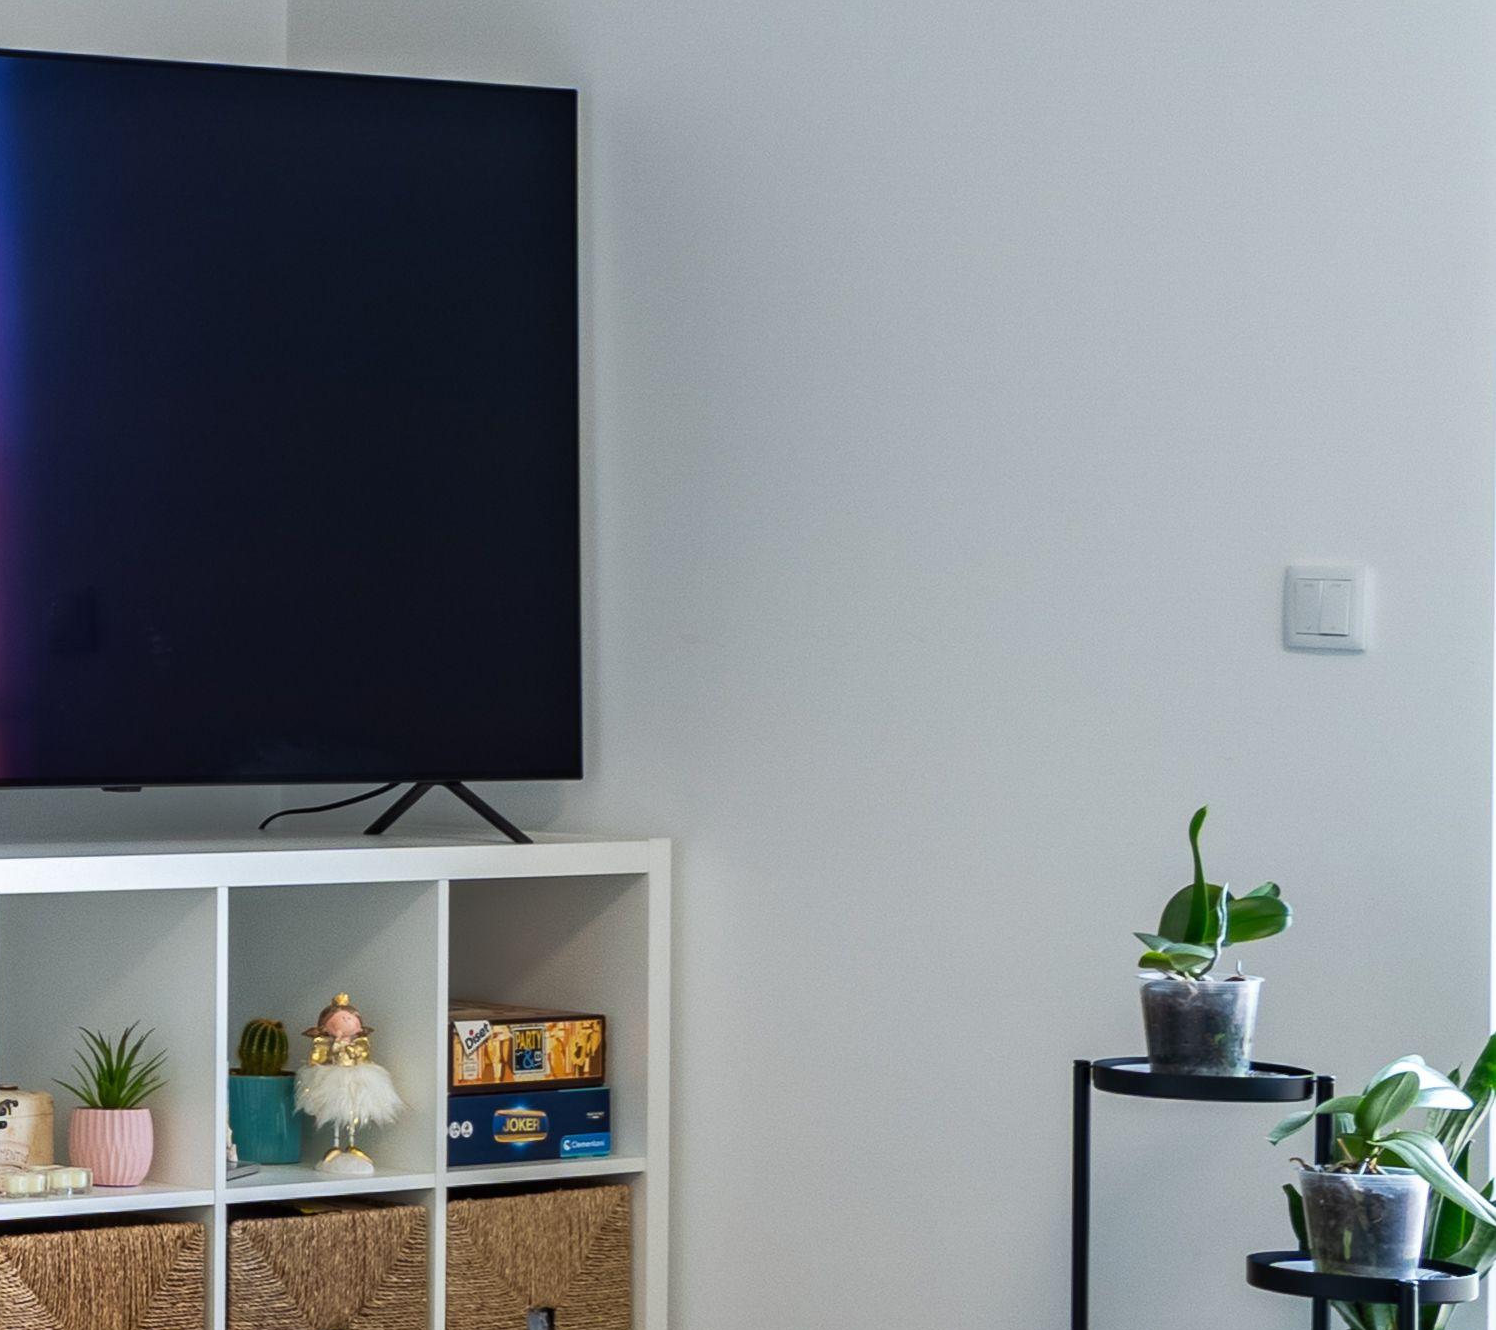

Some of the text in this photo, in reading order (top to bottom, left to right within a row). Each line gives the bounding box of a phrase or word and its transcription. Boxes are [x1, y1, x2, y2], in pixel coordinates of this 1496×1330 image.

[465, 1022, 490, 1050] Diset
[515, 1031, 543, 1050] PARTY
[522, 1050, 536, 1068] &
[503, 1118, 541, 1132] JOKER
